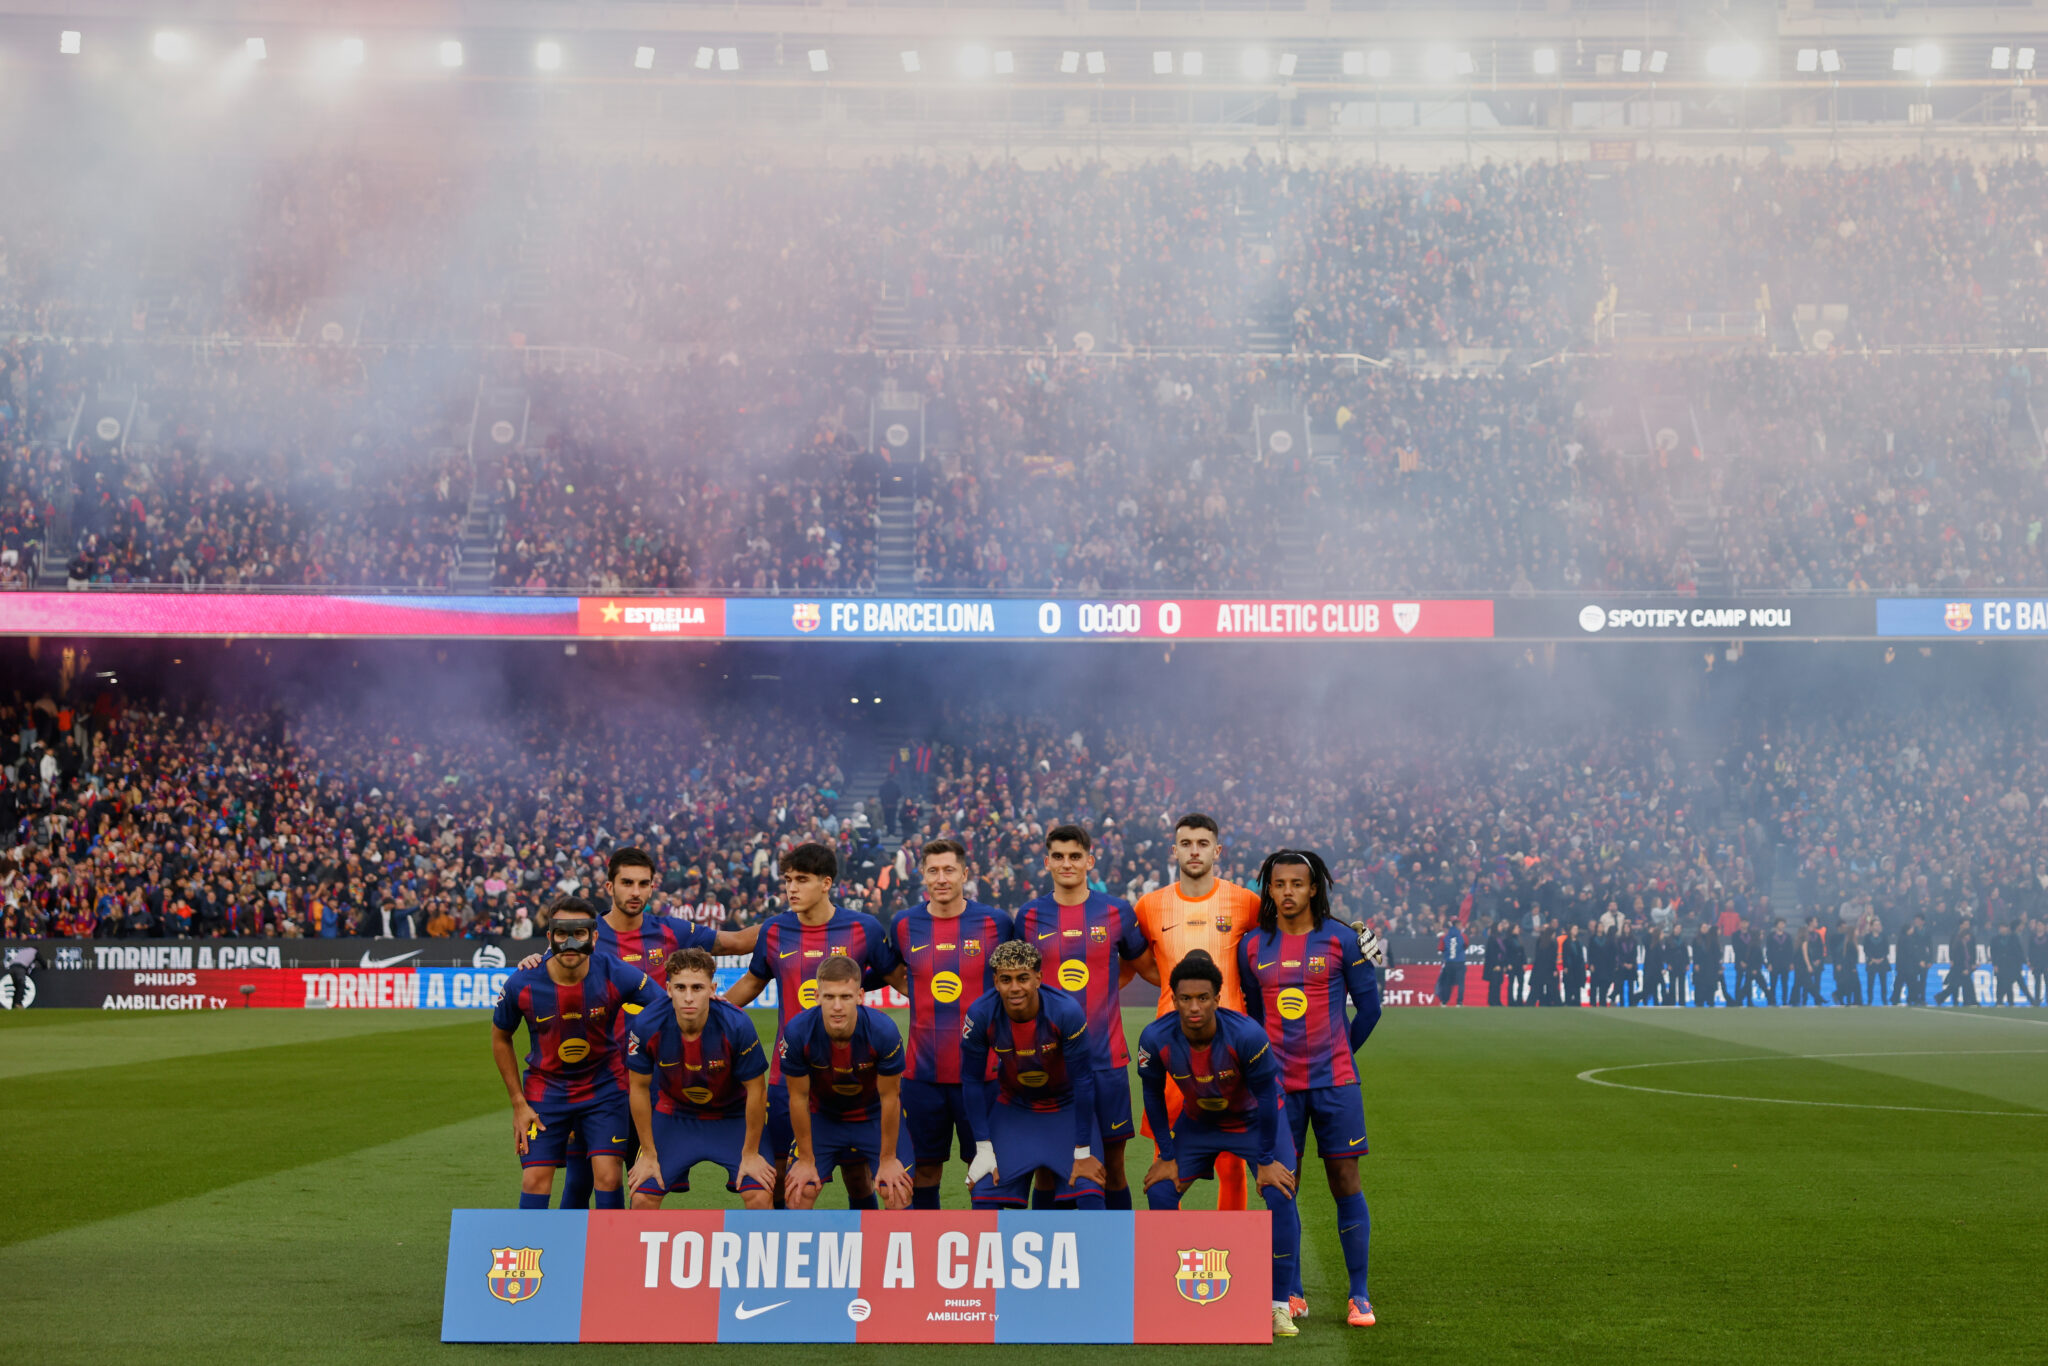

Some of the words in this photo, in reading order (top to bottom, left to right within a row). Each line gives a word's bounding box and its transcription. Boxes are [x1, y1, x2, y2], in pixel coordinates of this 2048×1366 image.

[624, 607, 705, 623] ESTRELLA
[831, 603, 859, 632] FC
[864, 603, 995, 632] BARCELONA
[1039, 602, 1061, 634] 0
[1079, 603, 1141, 632] 00:00
[1158, 602, 1182, 634] 0
[1216, 604, 1317, 632] ATHLETIC
[1322, 604, 1379, 632] CLUB
[1608, 609, 1688, 627] SPOTIFY
[1690, 608, 1747, 627] CAMP
[1750, 608, 1791, 627] NOU
[1983, 602, 2011, 631] FC
[2015, 602, 2048, 630] BA
[197, 946, 214, 970] A
[218, 946, 281, 970] CASA
[134, 972, 196, 986] PHILIPS
[302, 973, 420, 1009] TORNEM
[426, 973, 445, 1008] A
[452, 973, 509, 1008] CAS
[103, 994, 205, 1010] AMBILIGHT
[209, 996, 227, 1010] tv
[639, 1230, 863, 1289] TORNEM
[883, 1232, 915, 1289] A
[936, 1231, 1080, 1290] CASA
[945, 1299, 982, 1308] PHILIPS
[926, 1312, 987, 1322] AMBILIGHT
[989, 1313, 1000, 1322] tv
